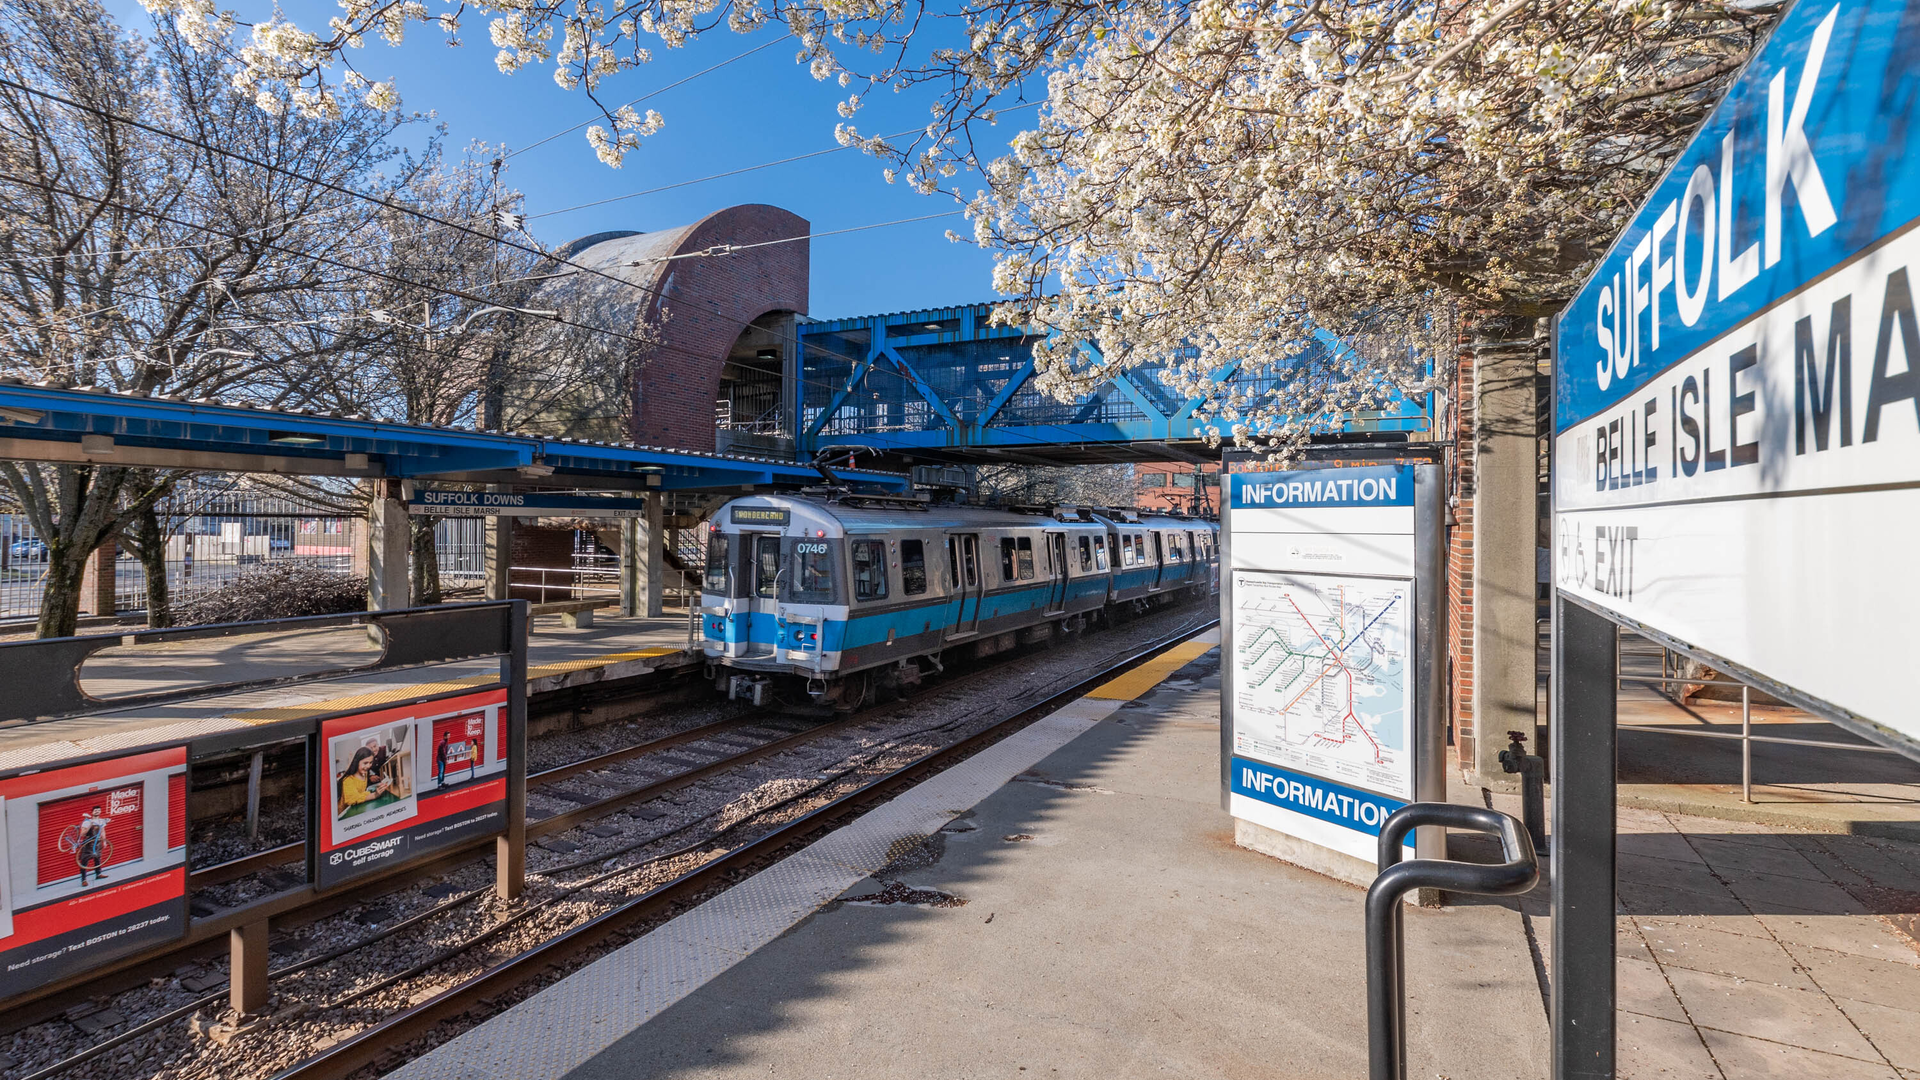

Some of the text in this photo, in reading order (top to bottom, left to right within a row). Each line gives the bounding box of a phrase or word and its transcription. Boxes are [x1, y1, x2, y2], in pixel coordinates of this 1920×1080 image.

[1596, 3, 1839, 392] SUFFOLK
[1596, 397, 1658, 493] BELLE
[1672, 343, 1760, 480] ISLE
[424, 492, 525, 506] SUFFOLK DOWNS
[1242, 477, 1397, 504] INFORMATION
[424, 506, 501, 515] BELLE ISLE MARSH
[797, 543, 826, 555] 0746
[1594, 526, 1639, 603] EXIT
[111, 788, 137, 800] Made
[111, 800, 121, 808] to
[414, 833, 426, 841] Need
[426, 827, 444, 837] storage?
[444, 824, 454, 832] Text
[454, 819, 471, 829] BOSTON
[352, 848, 394, 867] self storage
[7, 914, 171, 972] Need storage? Text BOSTON to 28237 today.
